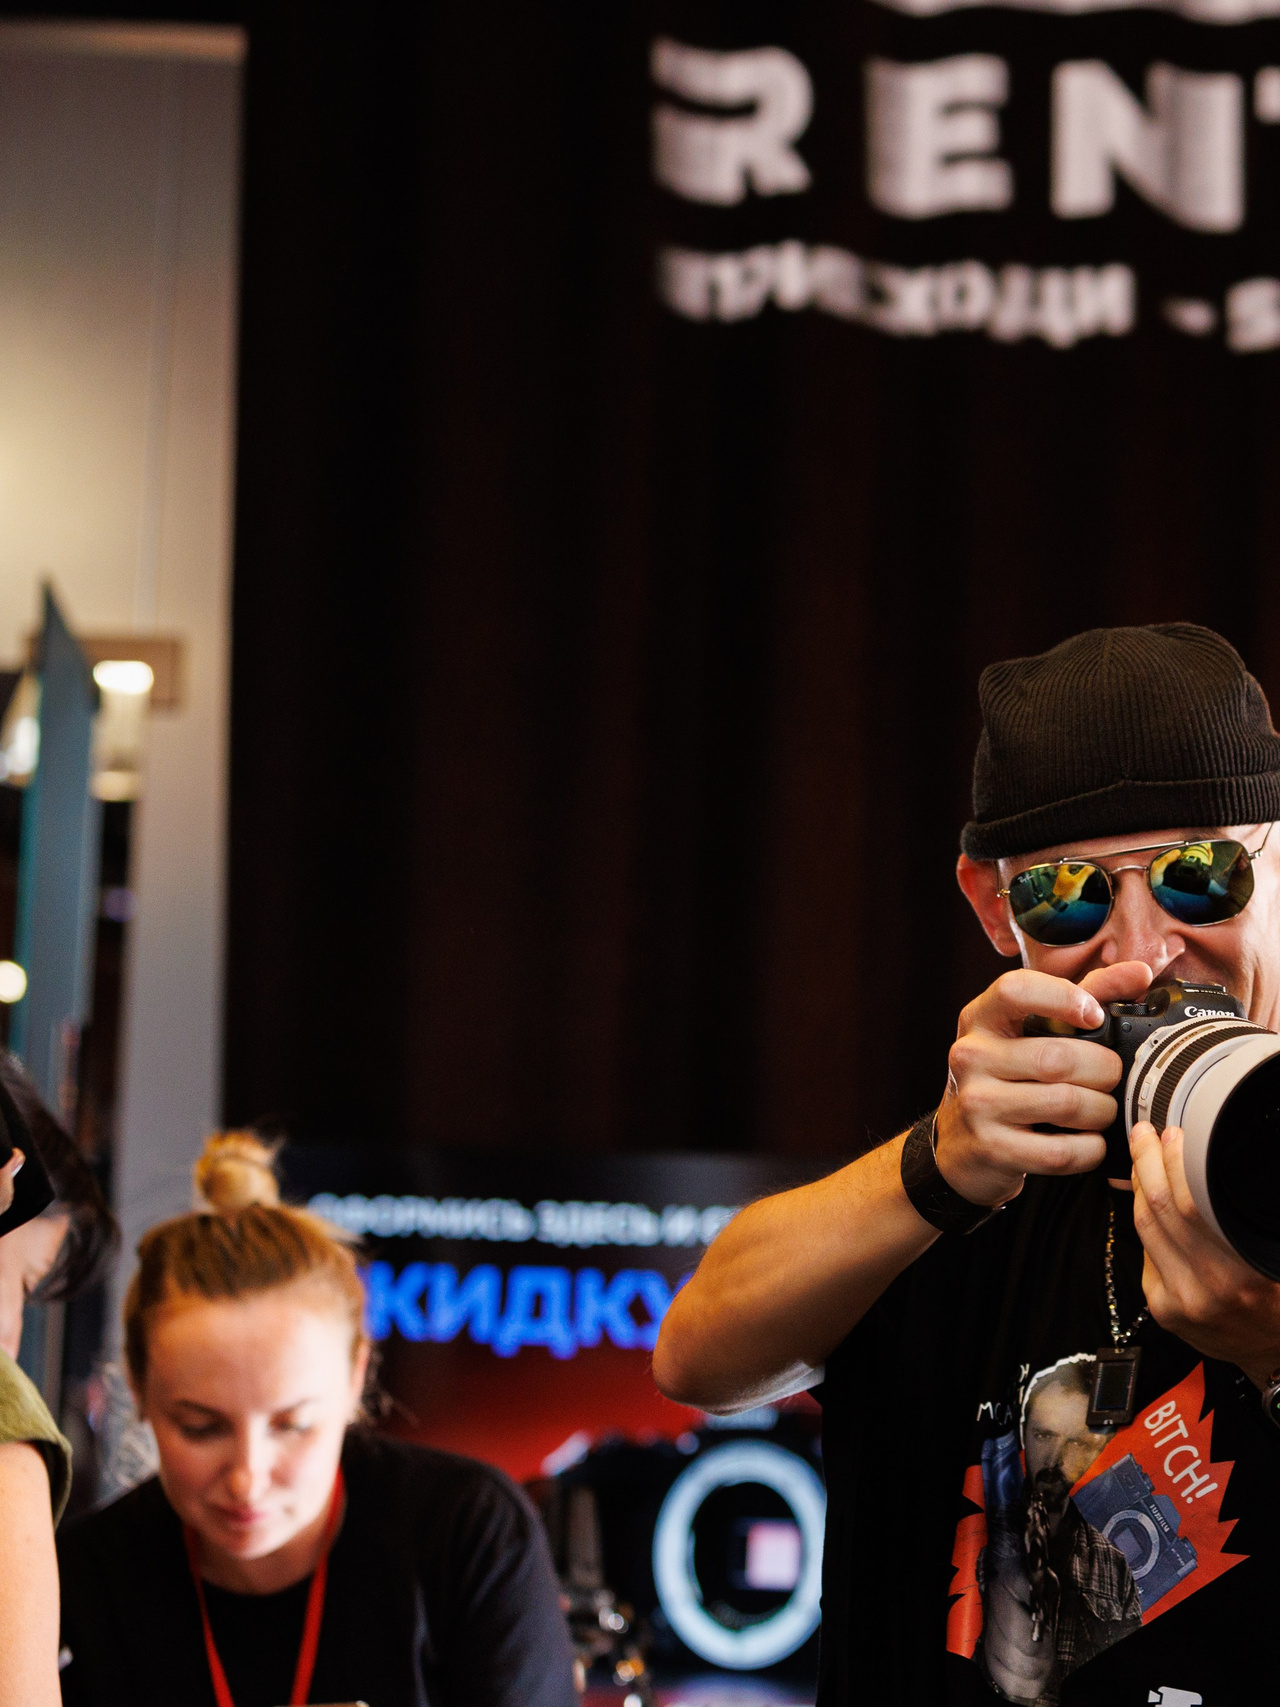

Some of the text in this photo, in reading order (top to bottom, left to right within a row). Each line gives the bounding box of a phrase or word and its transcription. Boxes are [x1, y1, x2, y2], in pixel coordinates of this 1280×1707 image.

[1184, 1005, 1235, 1018] Canon
[359, 1260, 697, 1359] КИДКУ
[1144, 1400, 1218, 1504] BITCH!
